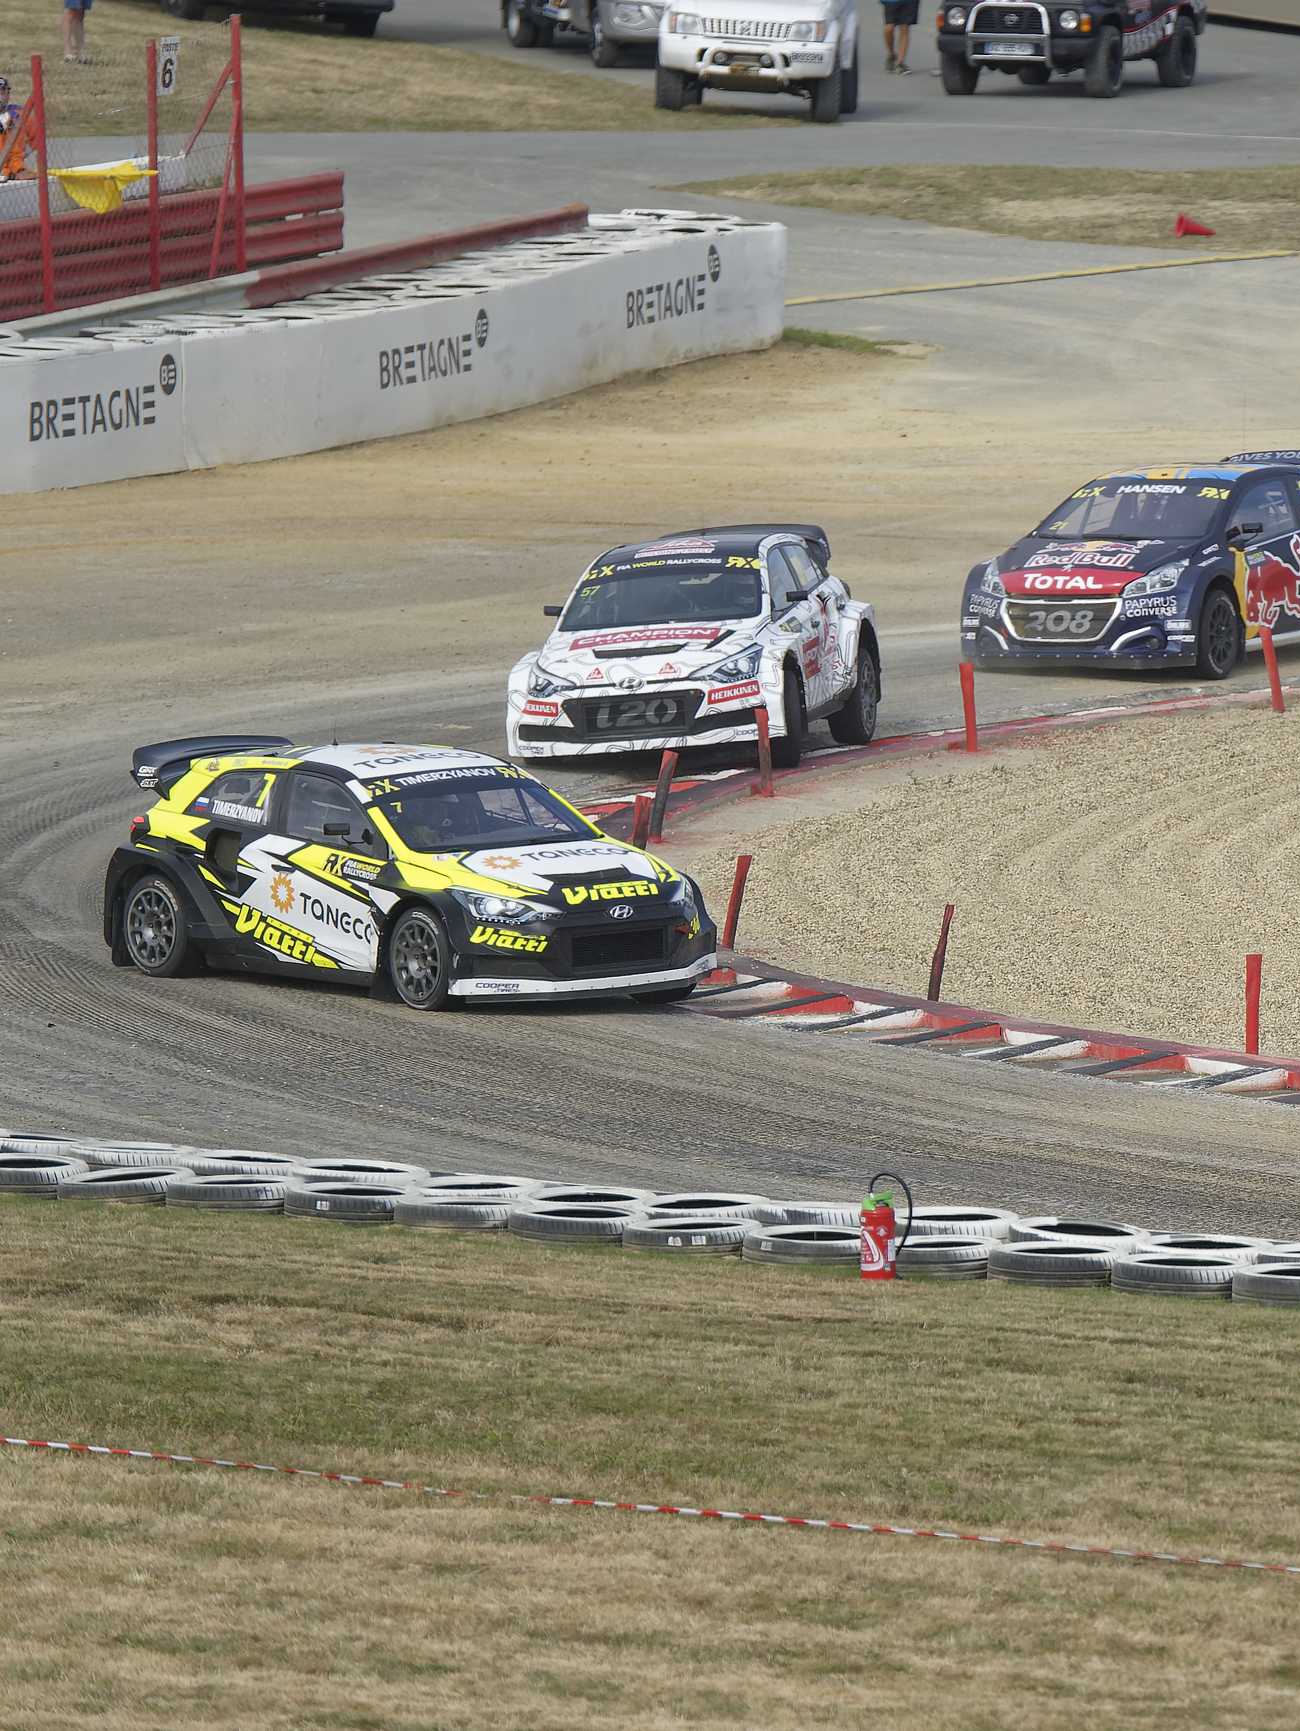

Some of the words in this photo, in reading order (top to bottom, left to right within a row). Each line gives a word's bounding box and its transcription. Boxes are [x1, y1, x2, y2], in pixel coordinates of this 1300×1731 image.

[162, 57, 174, 88] 6
[626, 273, 706, 329] BRETAGNE
[379, 333, 472, 389] BRETAGNE
[29, 384, 156, 442] BRETAGNE
[1116, 485, 1186, 495] HANSEN
[633, 560, 666, 569] WORLD
[666, 558, 722, 566] RALLYCROSS
[1024, 552, 1079, 568] Red
[1076, 552, 1136, 567] Bull
[1024, 573, 1103, 590] TOTAL
[580, 586, 601, 598] 57
[1125, 596, 1177, 610] PAPYRUS
[1025, 610, 1094, 633] 208
[578, 628, 712, 645] CHAMPION
[711, 684, 758, 700] HEIKKINEN
[395, 768, 496, 786] TIMERZYANOV
[255, 773, 276, 808] 7
[211, 800, 265, 824] TIMERZYANOV
[390, 802, 402, 813] 7
